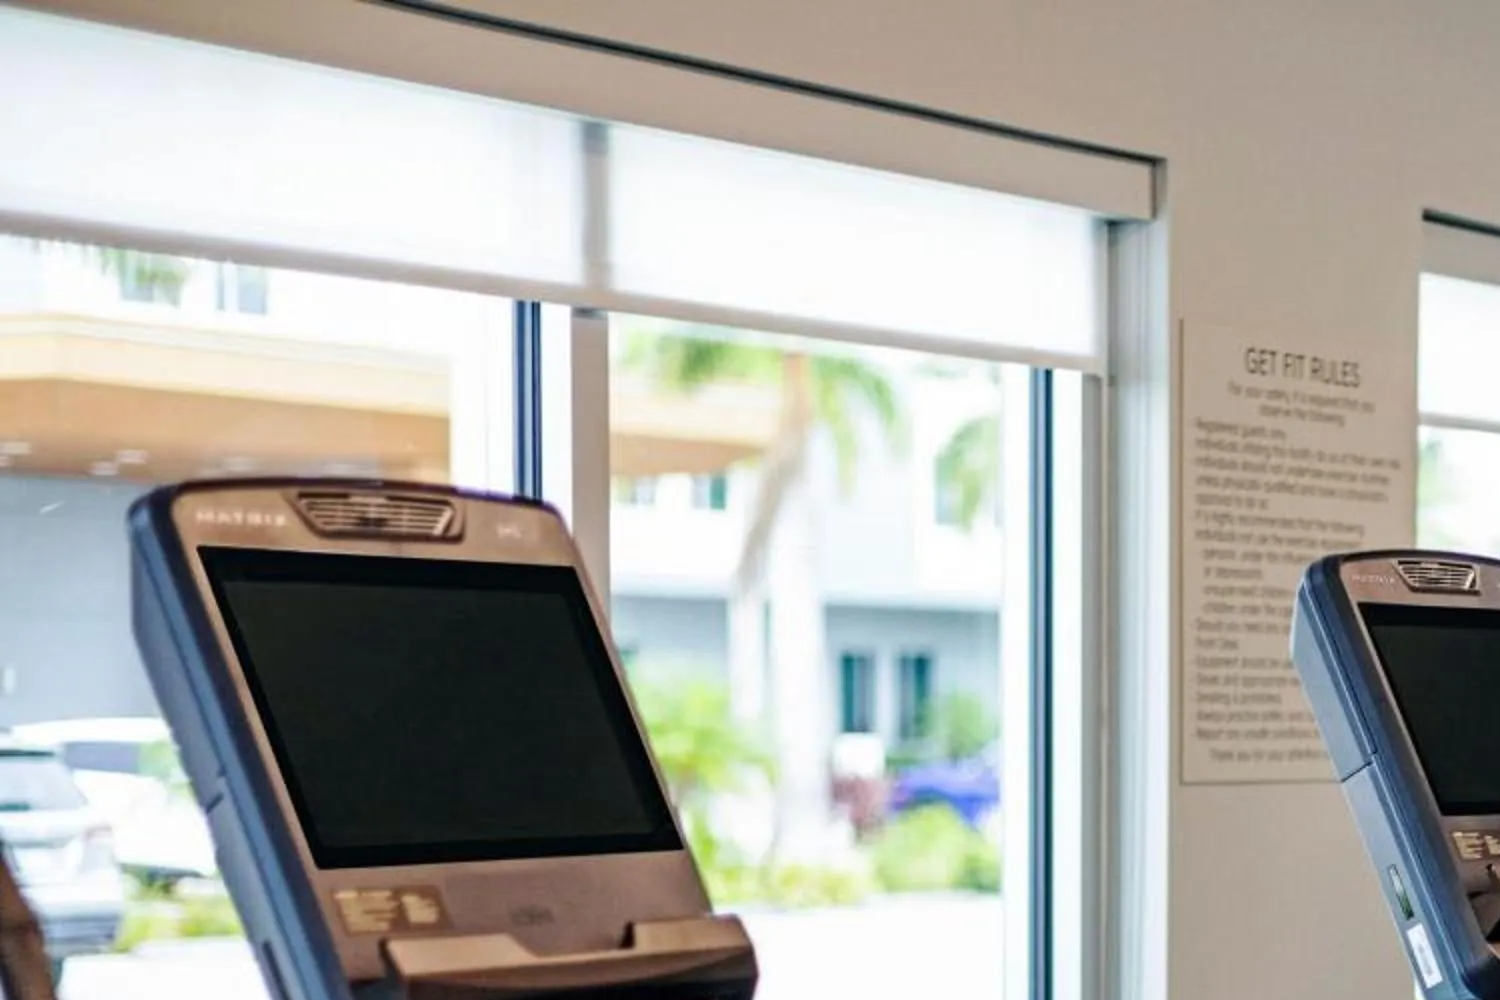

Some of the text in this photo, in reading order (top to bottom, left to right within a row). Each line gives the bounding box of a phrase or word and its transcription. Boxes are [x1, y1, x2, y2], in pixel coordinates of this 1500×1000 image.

[1246, 347, 1361, 388] GET FIT RULES
